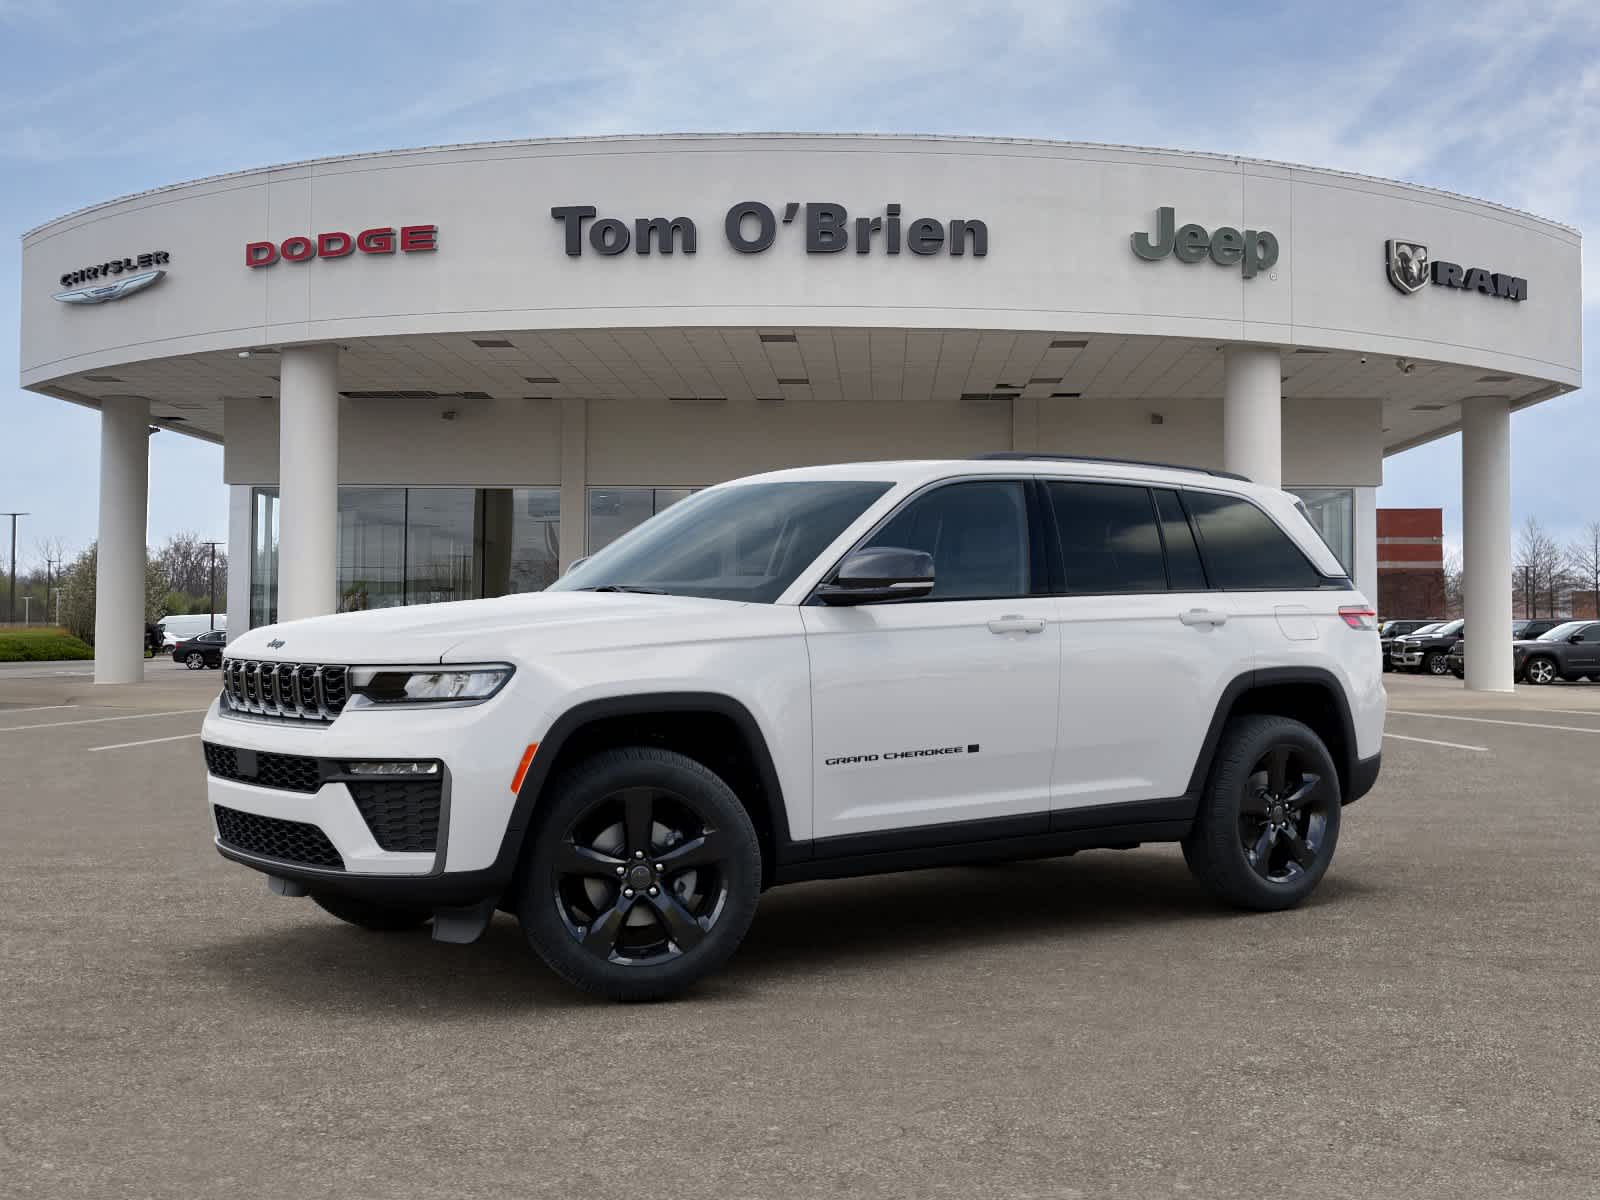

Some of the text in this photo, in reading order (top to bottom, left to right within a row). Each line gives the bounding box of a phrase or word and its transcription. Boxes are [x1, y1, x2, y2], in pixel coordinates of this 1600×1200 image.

[245, 224, 439, 268] DODGE
[551, 205, 697, 256] Tom
[1130, 206, 1279, 280] Jeep
[60, 250, 170, 287] CHRYSLER
[1431, 260, 1528, 302] RAM
[825, 746, 963, 765] GRAND CHEROKEE
